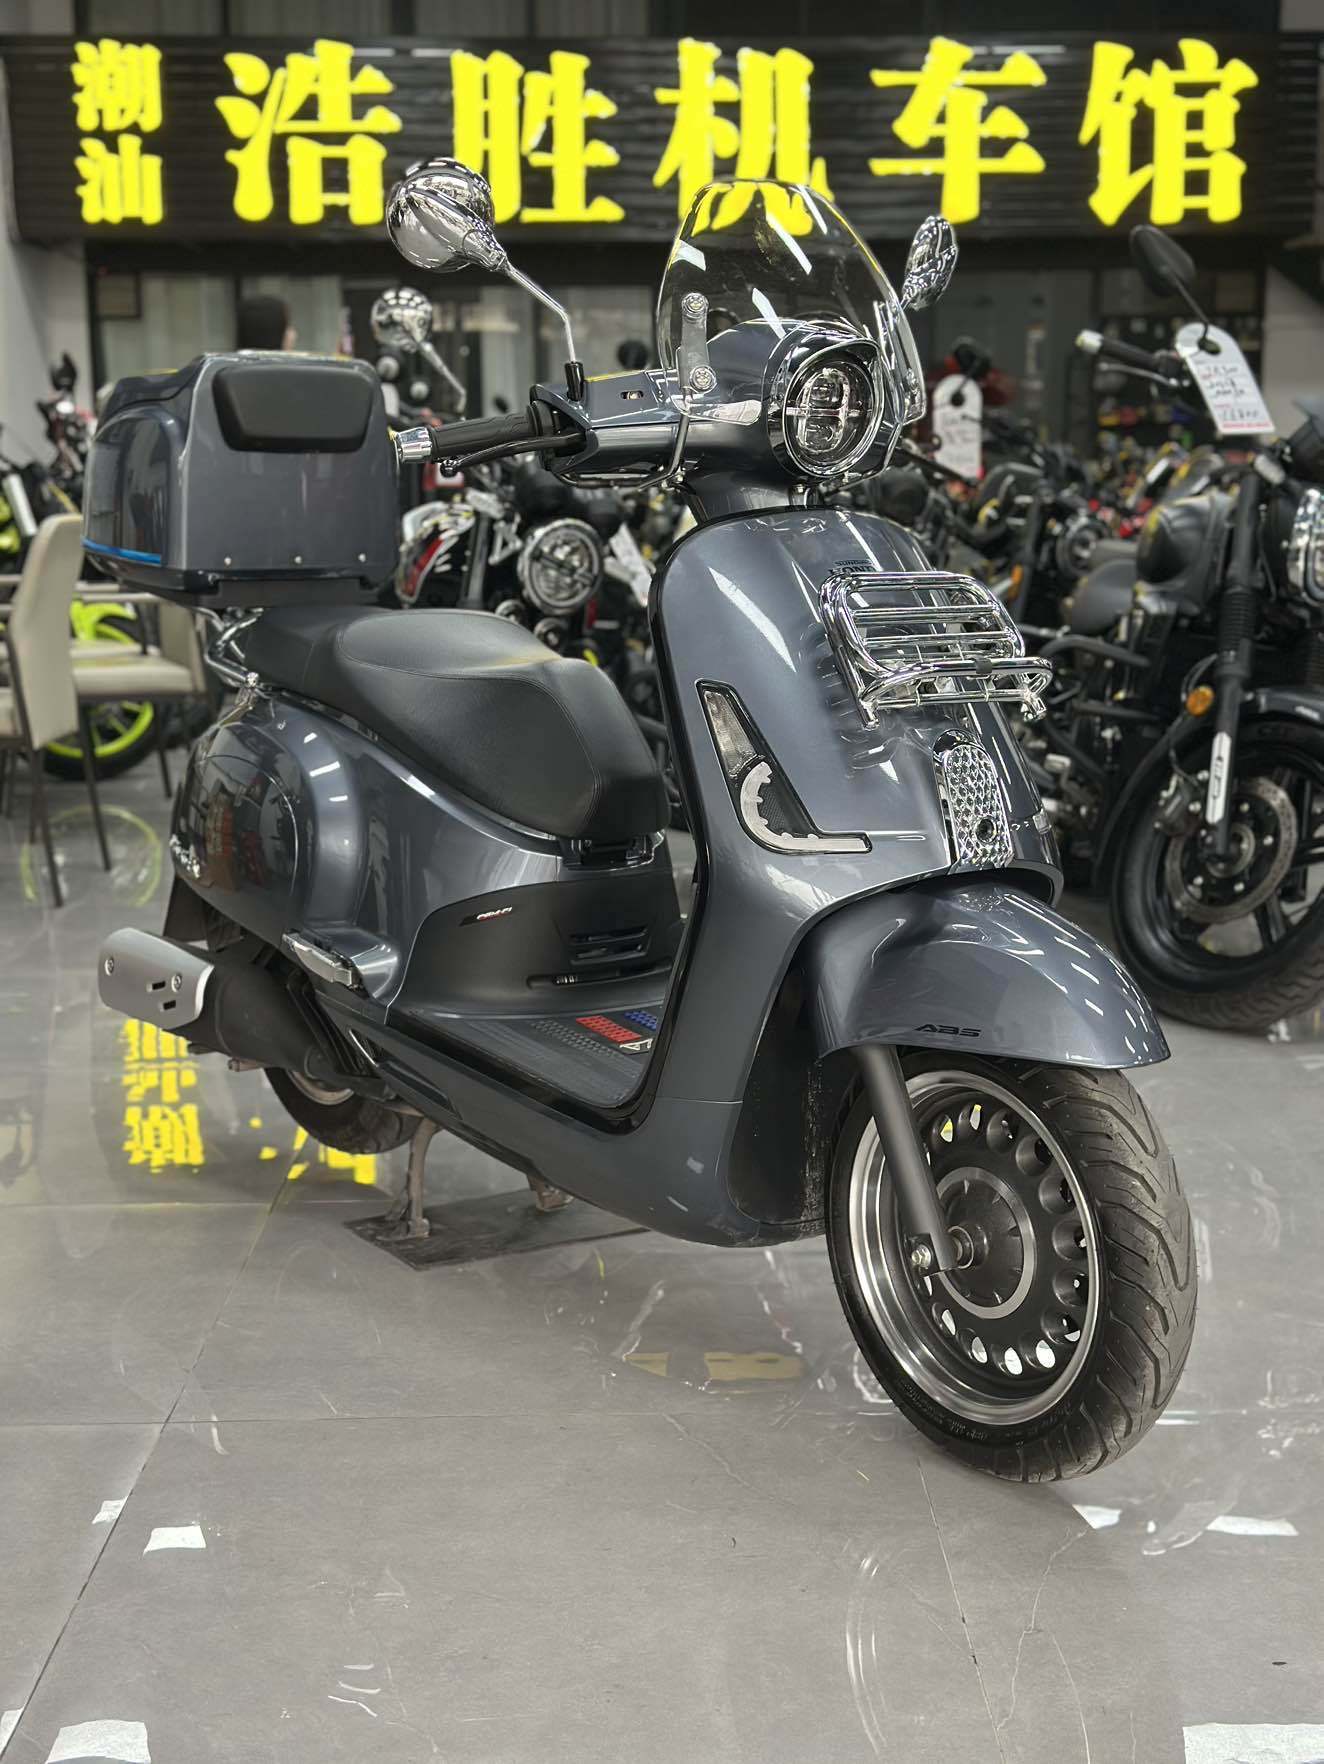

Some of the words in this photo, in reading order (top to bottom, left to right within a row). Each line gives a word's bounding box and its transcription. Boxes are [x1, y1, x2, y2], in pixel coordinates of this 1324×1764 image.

[71, 38, 163, 225] 潮汕
[214, 37, 1258, 235] 浩胜机车馆
[914, 1023, 982, 1037] ABS
